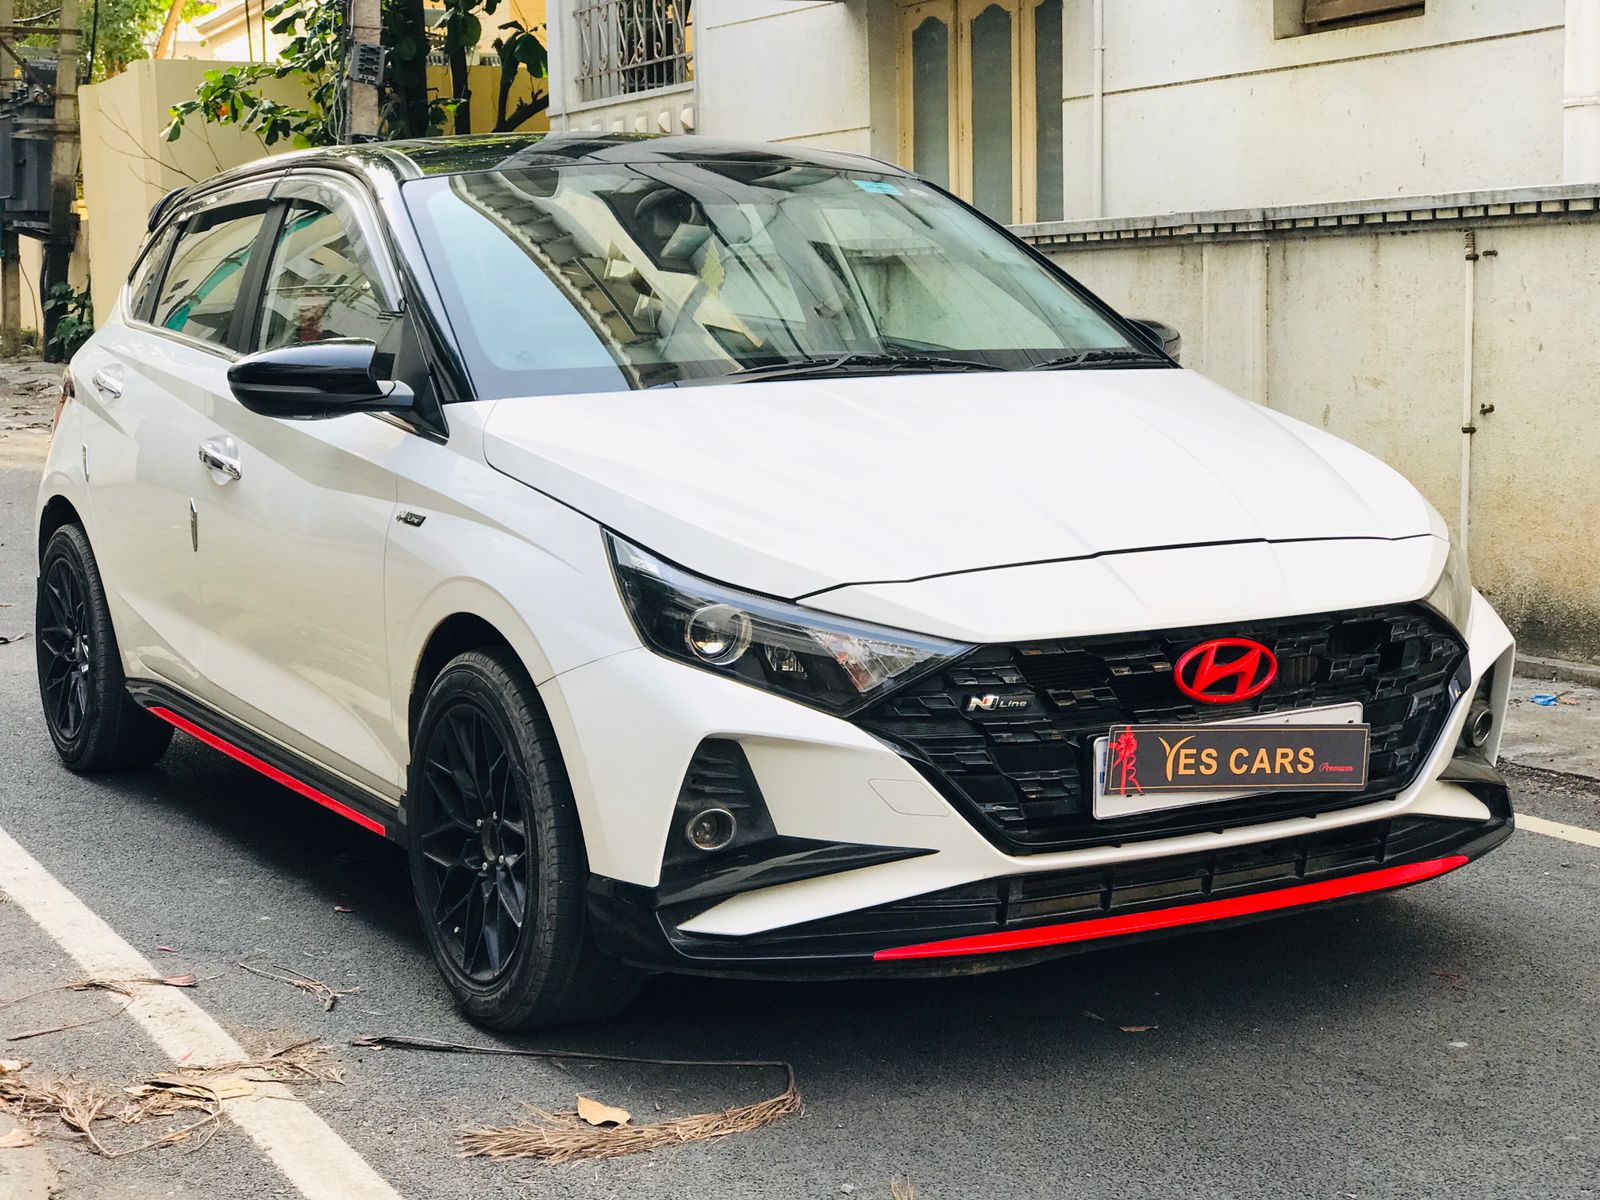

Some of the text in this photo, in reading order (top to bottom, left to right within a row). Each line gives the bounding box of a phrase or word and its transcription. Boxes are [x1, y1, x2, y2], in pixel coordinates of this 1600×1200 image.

[1000, 700, 1027, 708] Line
[1158, 735, 1218, 782] YES
[1229, 747, 1315, 774] CARS
